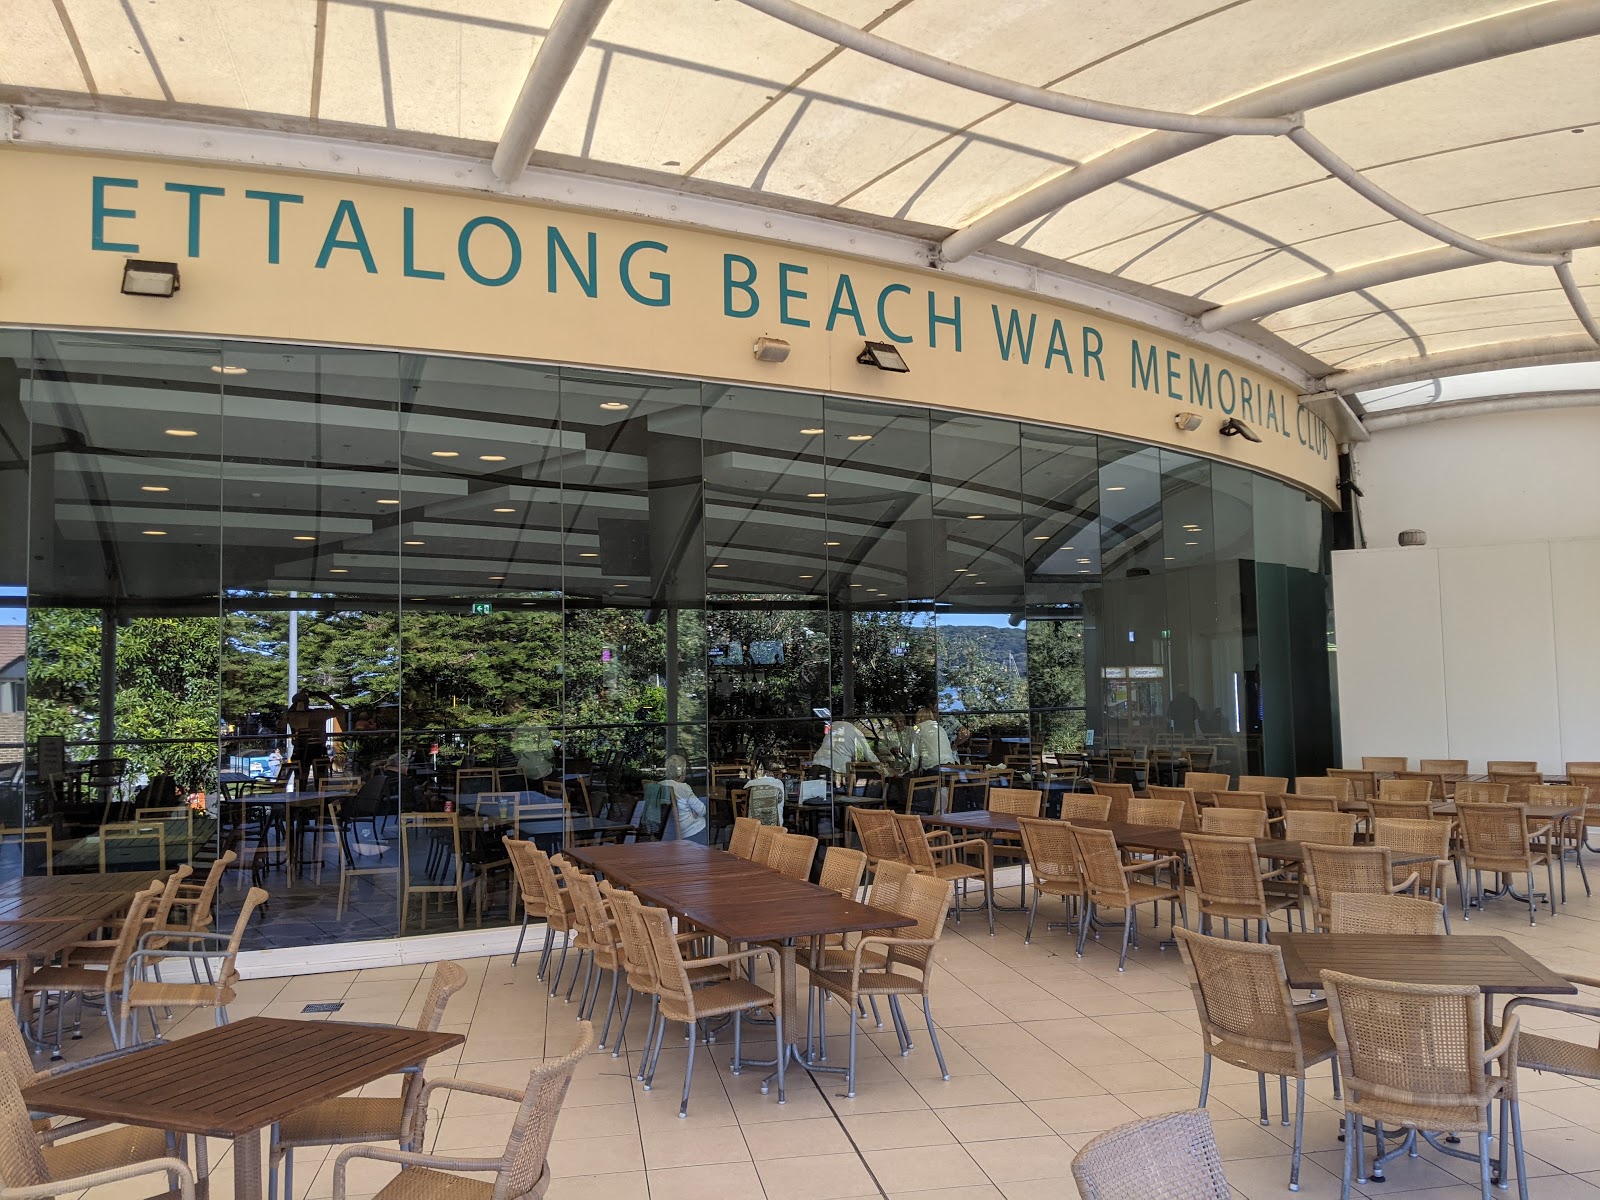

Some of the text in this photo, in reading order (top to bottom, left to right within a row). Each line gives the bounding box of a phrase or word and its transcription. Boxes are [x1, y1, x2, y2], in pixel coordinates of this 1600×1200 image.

[92, 176, 1329, 461] ETTALONG BEACH WAR MEMORIAL CLUB
